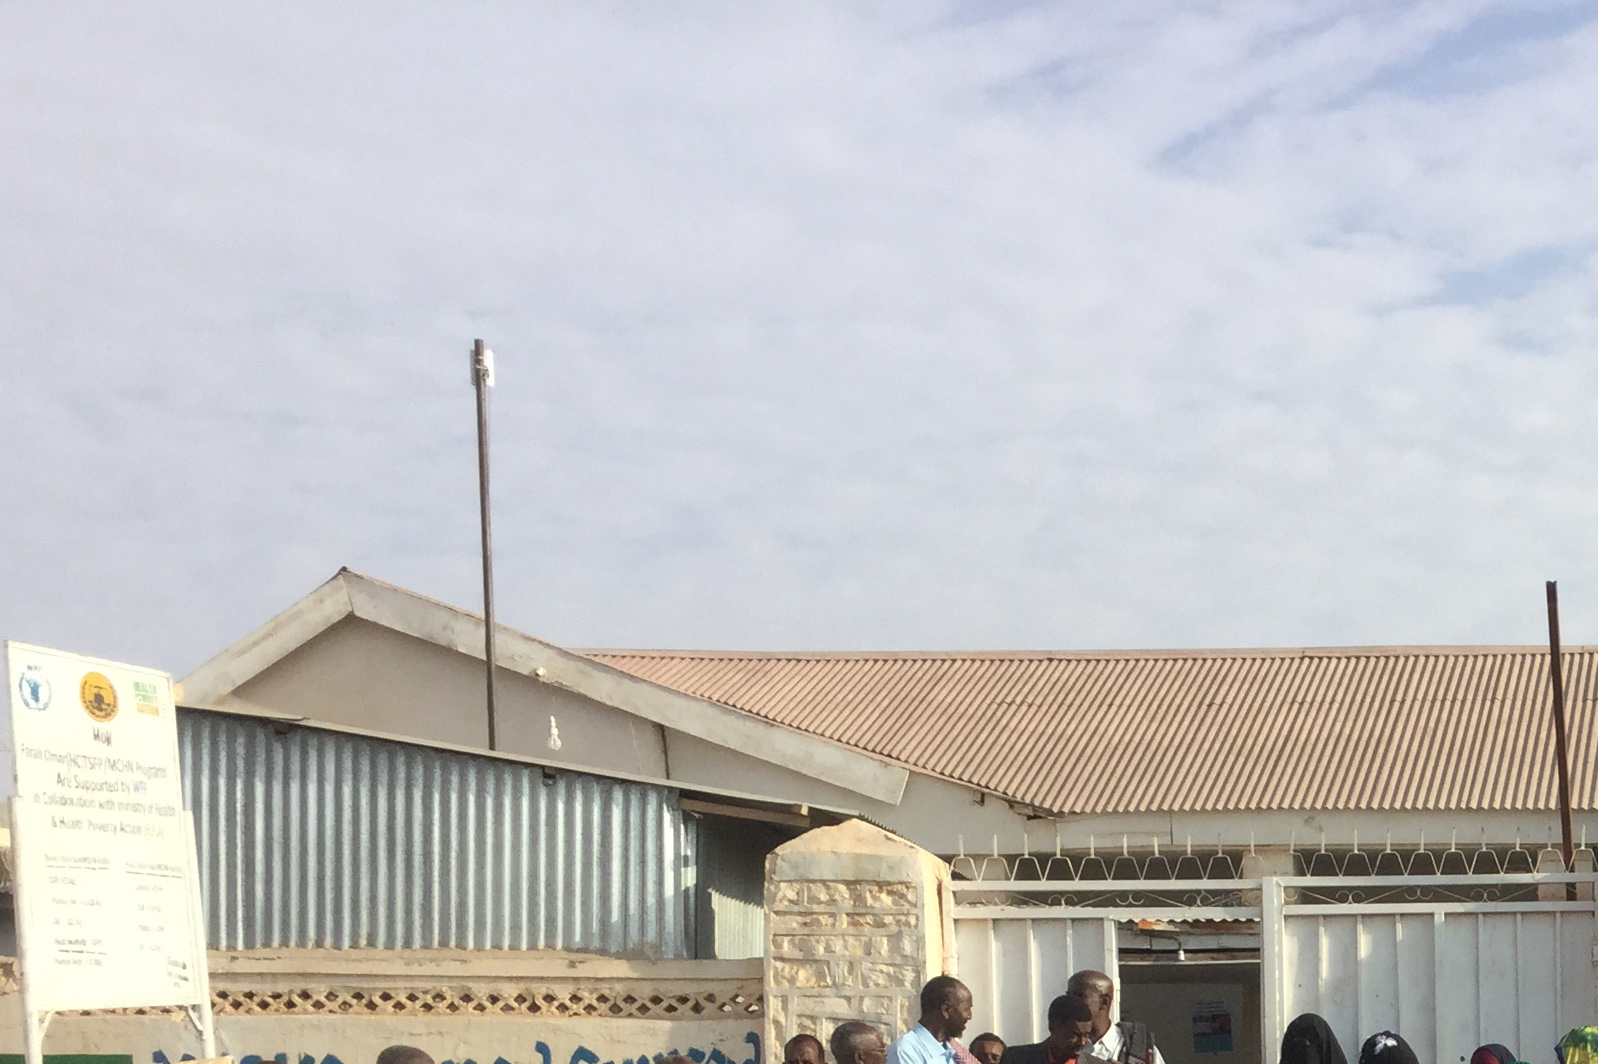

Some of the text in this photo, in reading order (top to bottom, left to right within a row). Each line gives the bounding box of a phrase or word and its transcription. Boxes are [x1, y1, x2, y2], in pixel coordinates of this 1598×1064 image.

[136, 761, 168, 780] Programs
[57, 772, 72, 788] Are
[74, 775, 119, 793] Supported
[121, 778, 130, 797] by
[98, 797, 116, 811] with
[147, 801, 154, 815] of
[154, 803, 176, 817] Health
[88, 818, 118, 836] Poverty
[120, 821, 142, 835] Action
